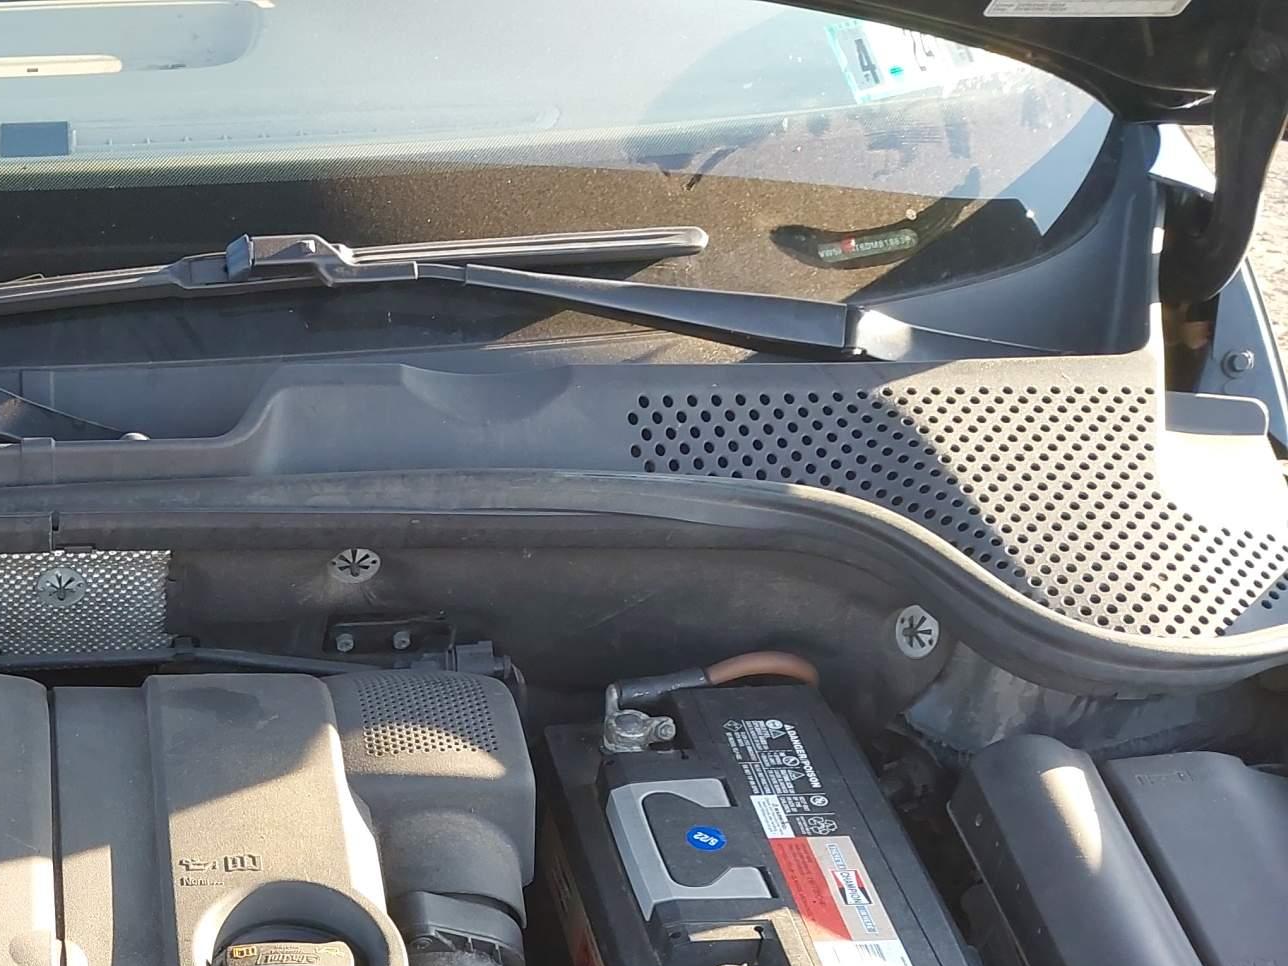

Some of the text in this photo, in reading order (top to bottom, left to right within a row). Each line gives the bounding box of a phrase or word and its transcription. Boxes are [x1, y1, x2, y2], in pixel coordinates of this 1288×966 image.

[854, 39, 880, 84] 4
[787, 730, 822, 788] DANGER/POISON
[840, 870, 863, 904] CHAMPION
